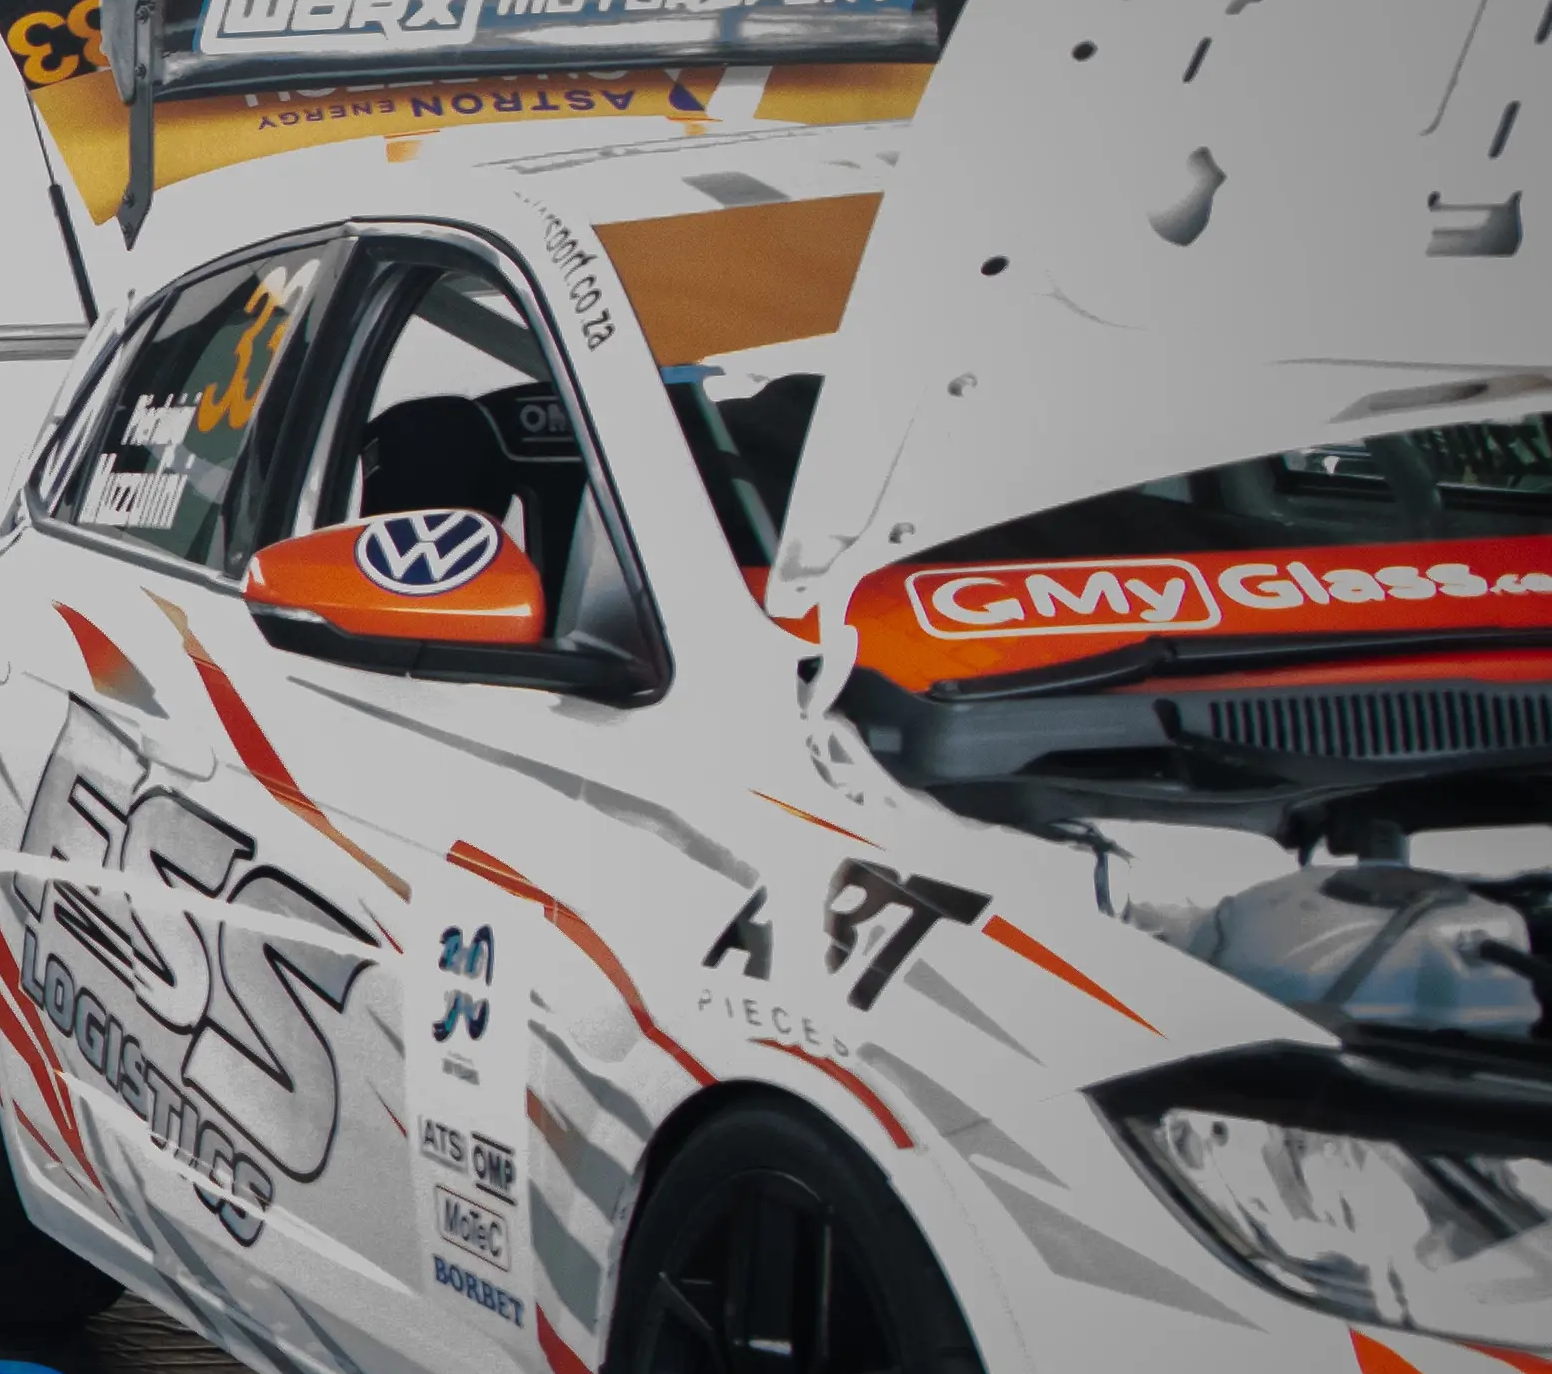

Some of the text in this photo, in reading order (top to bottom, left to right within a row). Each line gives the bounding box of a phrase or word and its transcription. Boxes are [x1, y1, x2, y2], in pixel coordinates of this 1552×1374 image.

[258, 97, 396, 131] ENERGY
[409, 88, 637, 120] ASTRON
[19, 924, 276, 1249] LOGISTICS
[423, 1120, 516, 1192] ATS OMP
[432, 1253, 525, 1329] BORBET
